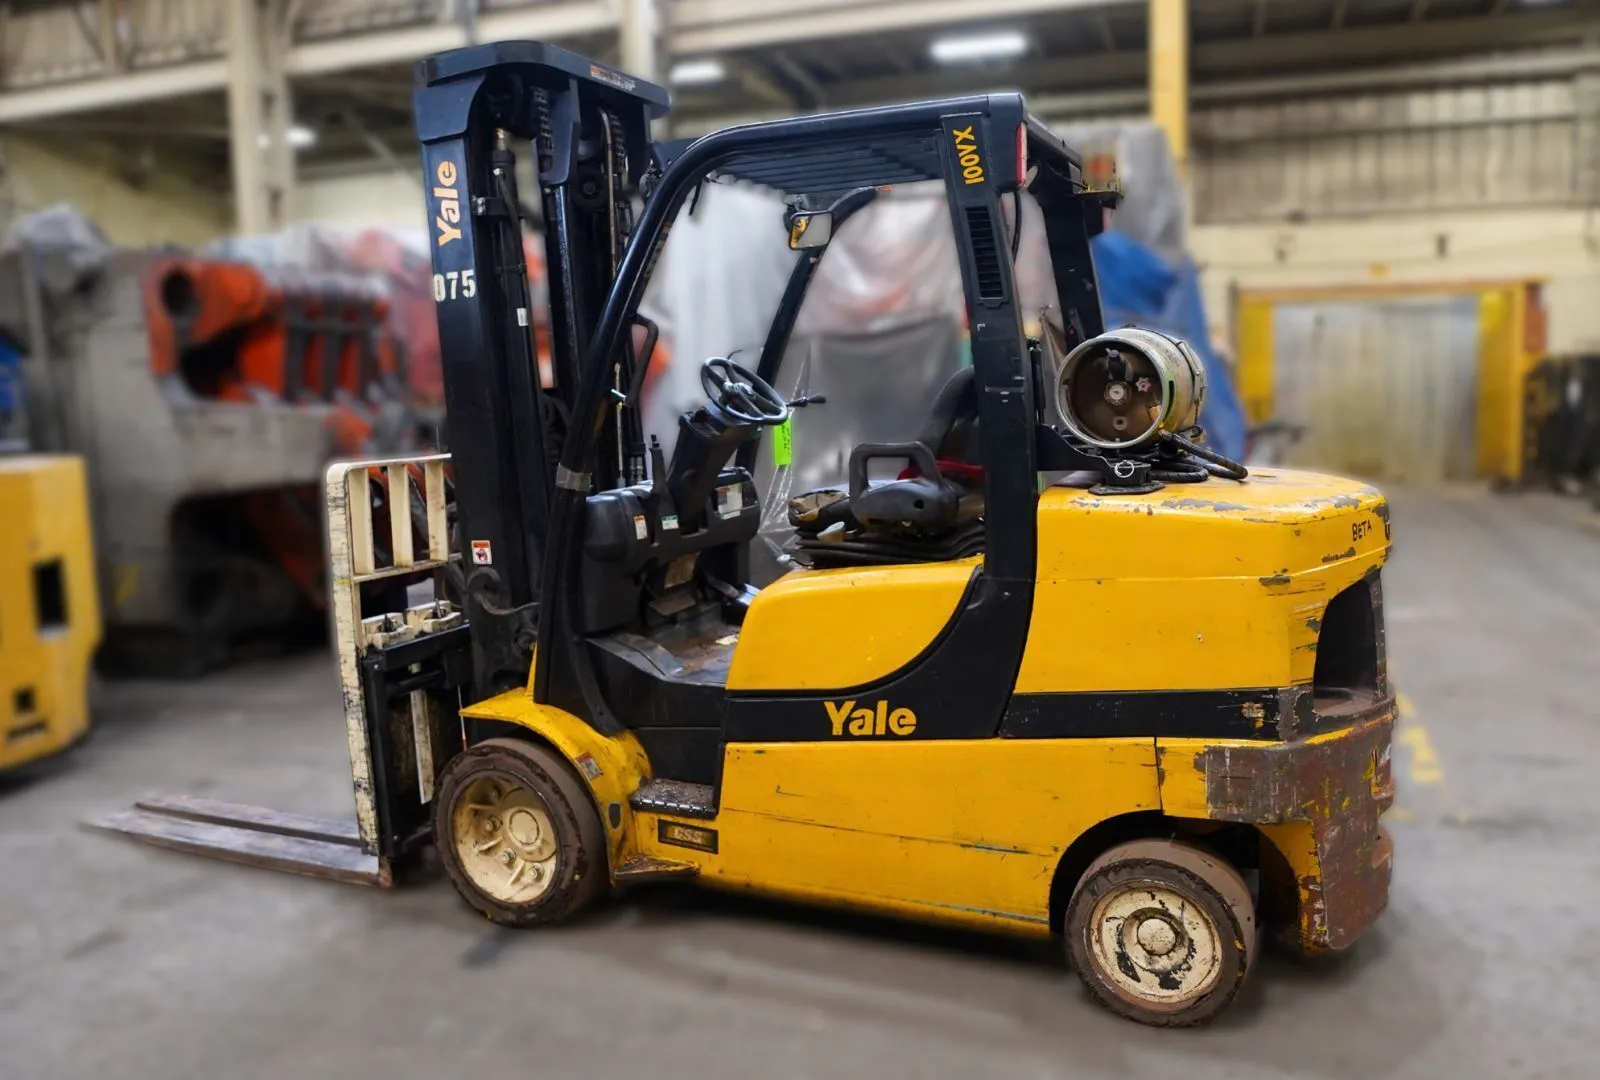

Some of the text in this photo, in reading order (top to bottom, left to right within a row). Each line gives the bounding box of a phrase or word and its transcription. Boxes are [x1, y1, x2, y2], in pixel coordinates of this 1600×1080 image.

[953, 125, 984, 185] 100VX
[434, 160, 462, 247] Yale
[433, 269, 476, 302] 075
[1352, 519, 1372, 542] BETA
[824, 700, 917, 736] Yale
